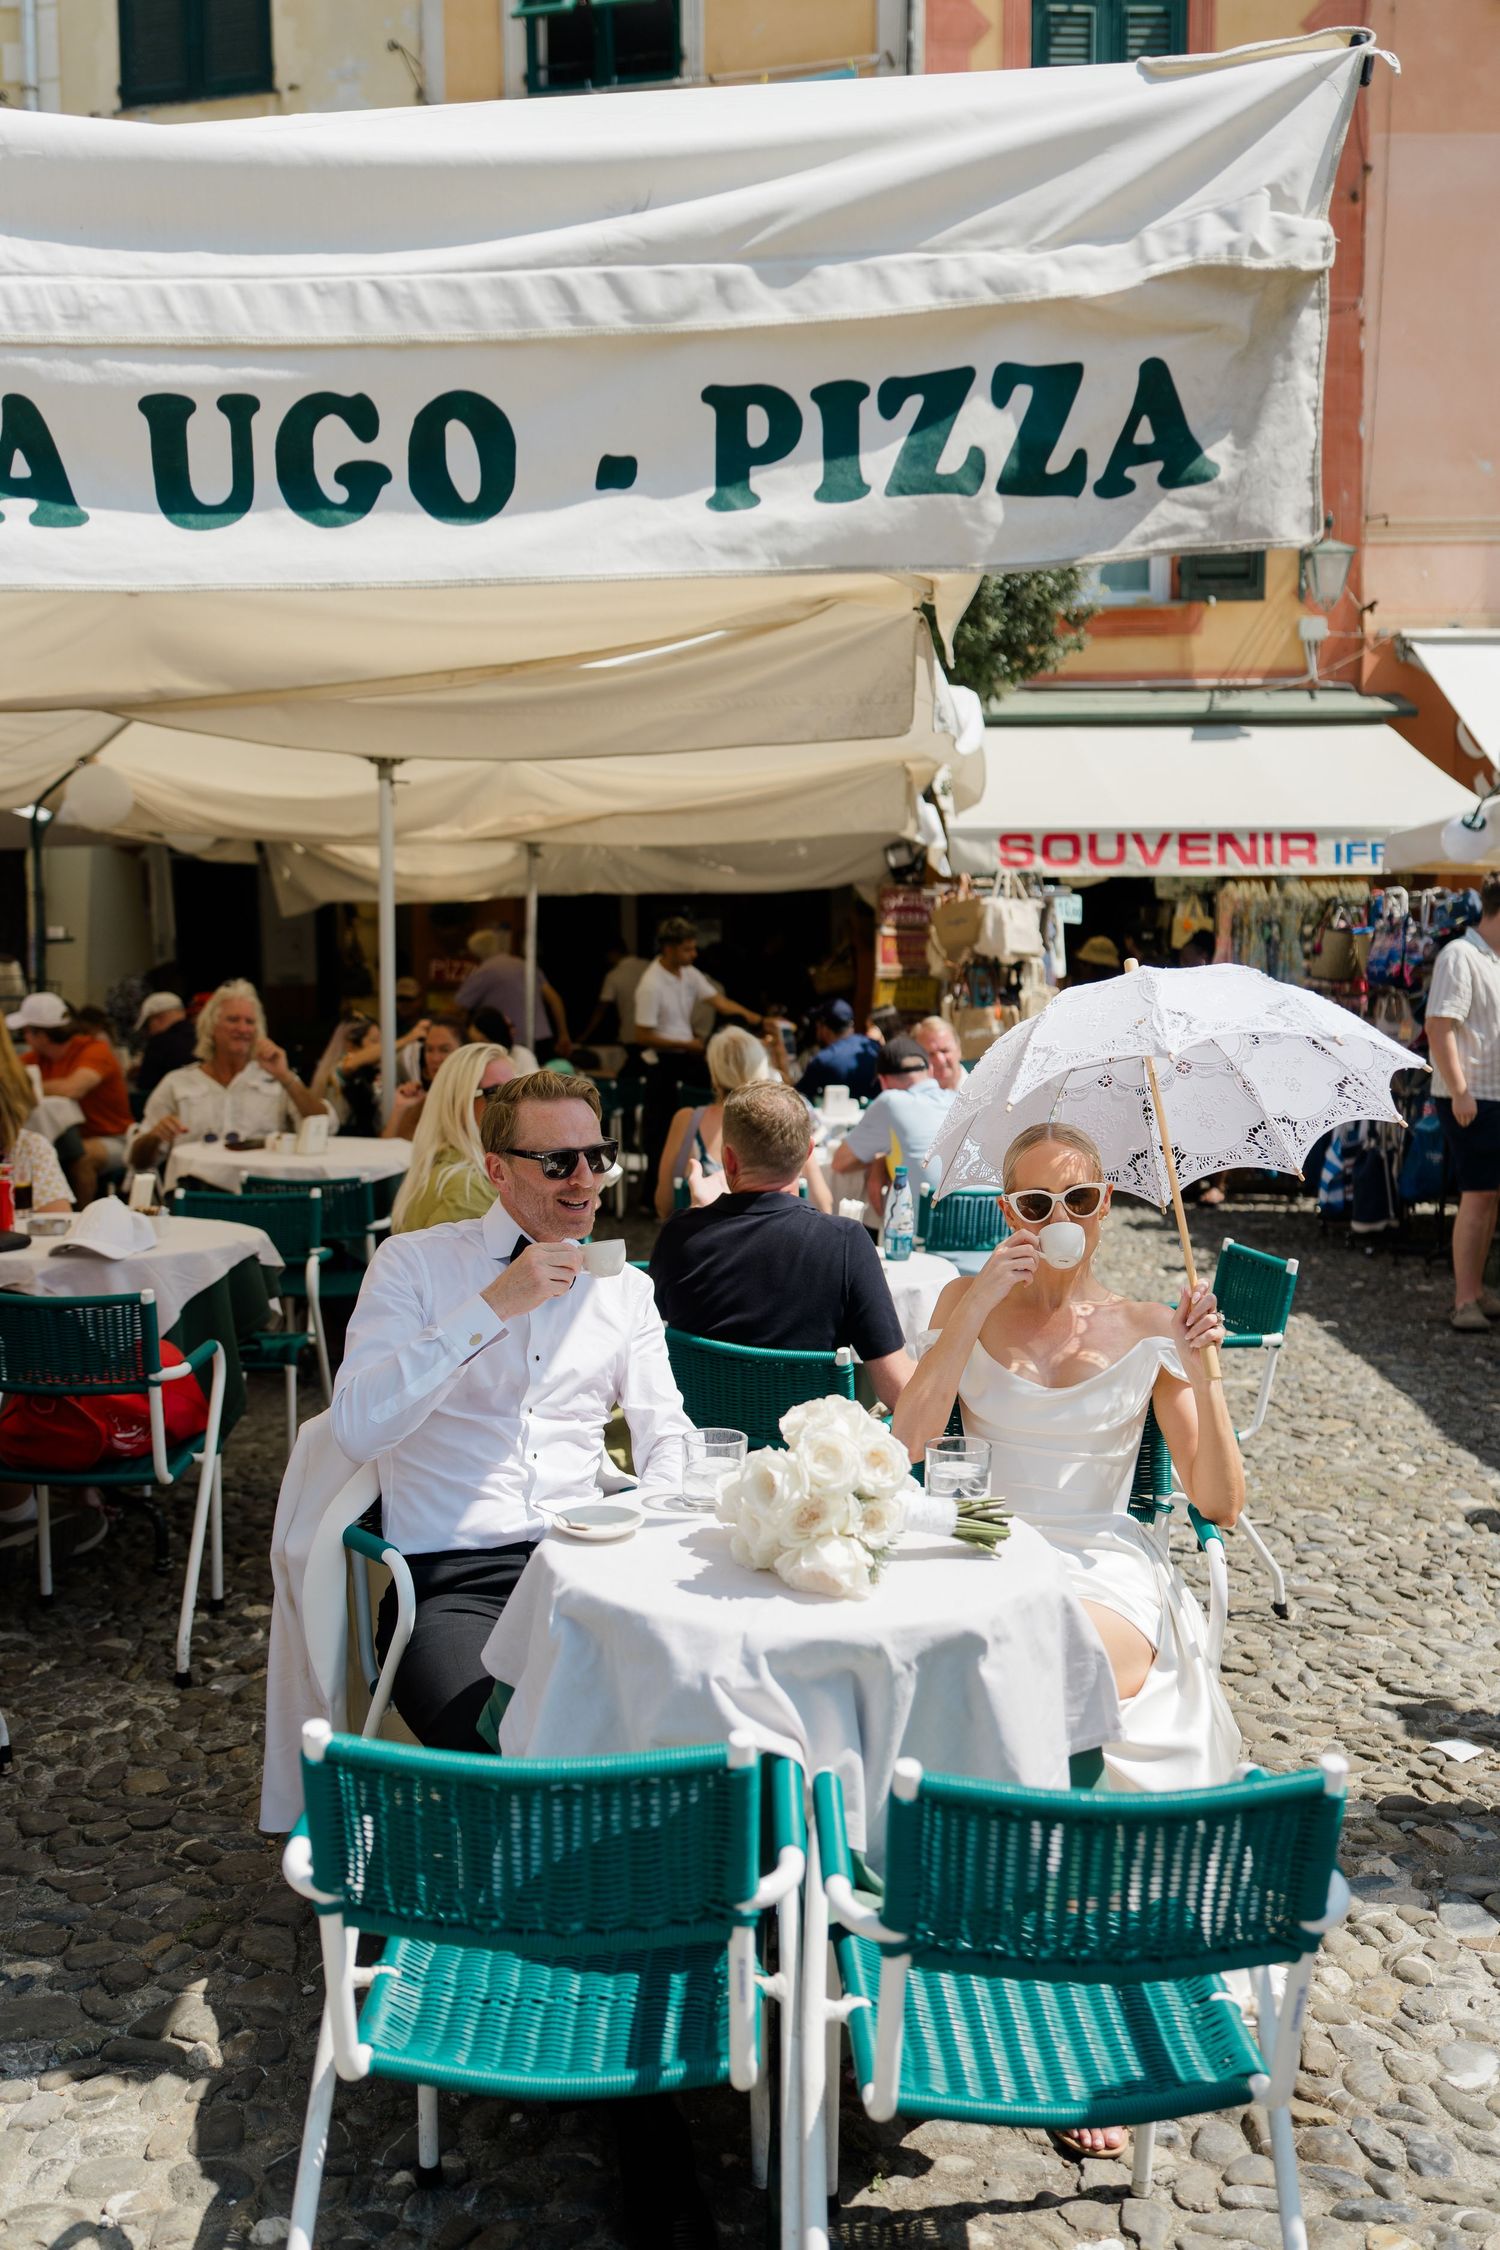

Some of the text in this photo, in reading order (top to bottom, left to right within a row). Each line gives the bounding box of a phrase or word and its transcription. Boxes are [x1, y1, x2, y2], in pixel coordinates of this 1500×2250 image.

[138, 389, 516, 531] UGO
[701, 357, 1220, 512] PIZZA
[999, 832, 1318, 867] SOUVENIR
